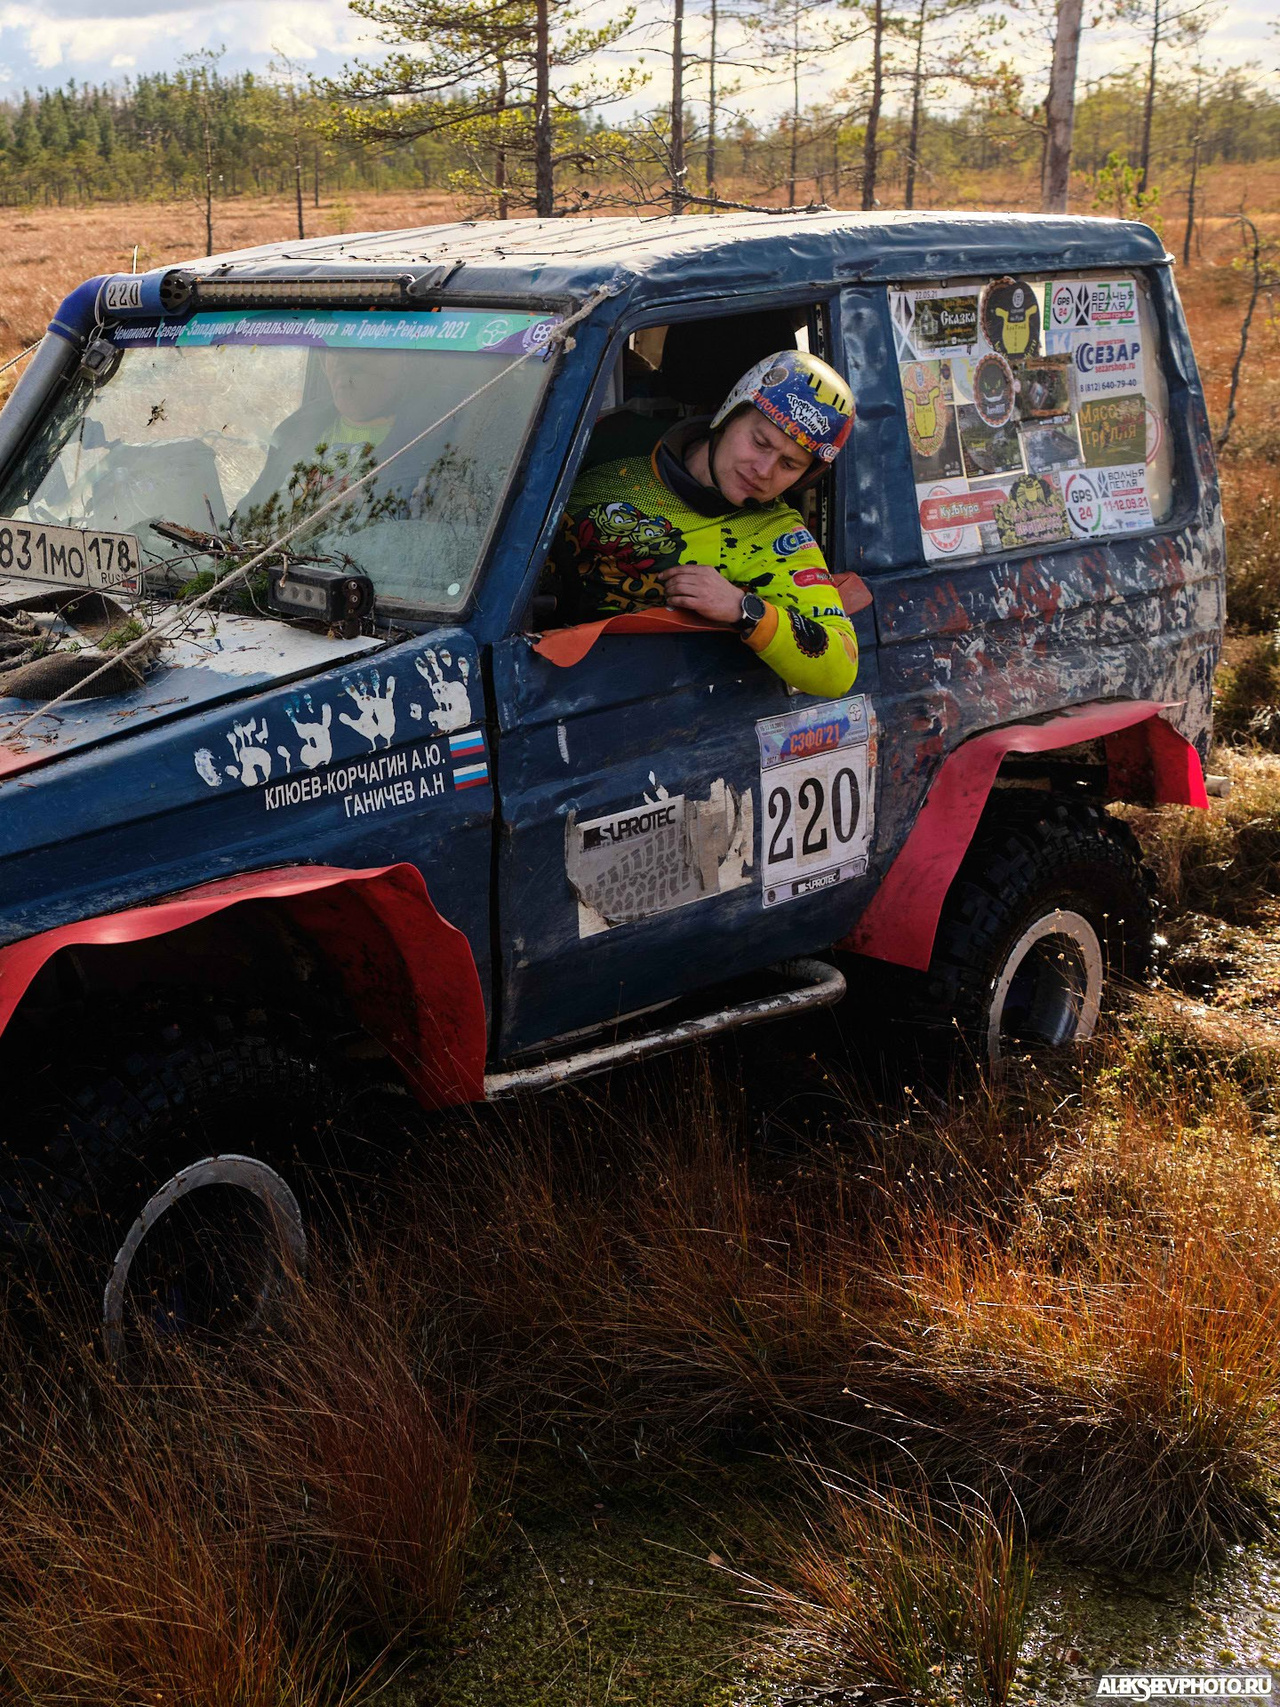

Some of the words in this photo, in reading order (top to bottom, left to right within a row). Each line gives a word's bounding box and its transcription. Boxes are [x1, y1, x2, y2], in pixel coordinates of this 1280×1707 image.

[108, 282, 139, 307] 220
[1057, 296, 1070, 305] GPS
[1091, 290, 1135, 302] ВОЛЧЬЯ
[1058, 308, 1067, 317] 24
[1091, 301, 1126, 312] ПЕТЛЯ
[113, 325, 156, 340] Чемпионат
[154, 320, 233, 340] Северо-Западного
[303, 318, 339, 339] Округа
[341, 323, 357, 337] по
[357, 319, 438, 340] Трофи-Рейдам
[436, 320, 470, 339] 2021
[1086, 342, 1140, 365] СЕЗАР
[1107, 468, 1145, 481] ВОЛЧЬЯ
[1109, 479, 1138, 489] ПЕТЛЯ
[1071, 489, 1093, 503] GPS
[1078, 506, 1093, 520] 24
[264, 752, 408, 811] КЛЮЕВ-КОРЧАГИН
[411, 743, 446, 772] А.Ю.
[343, 779, 416, 818] ГАНИЧЕВ
[419, 772, 446, 799] А.Н
[599, 804, 676, 842] SUPROTEC
[767, 767, 861, 865] 220
[802, 873, 837, 891] SUPROTEC
